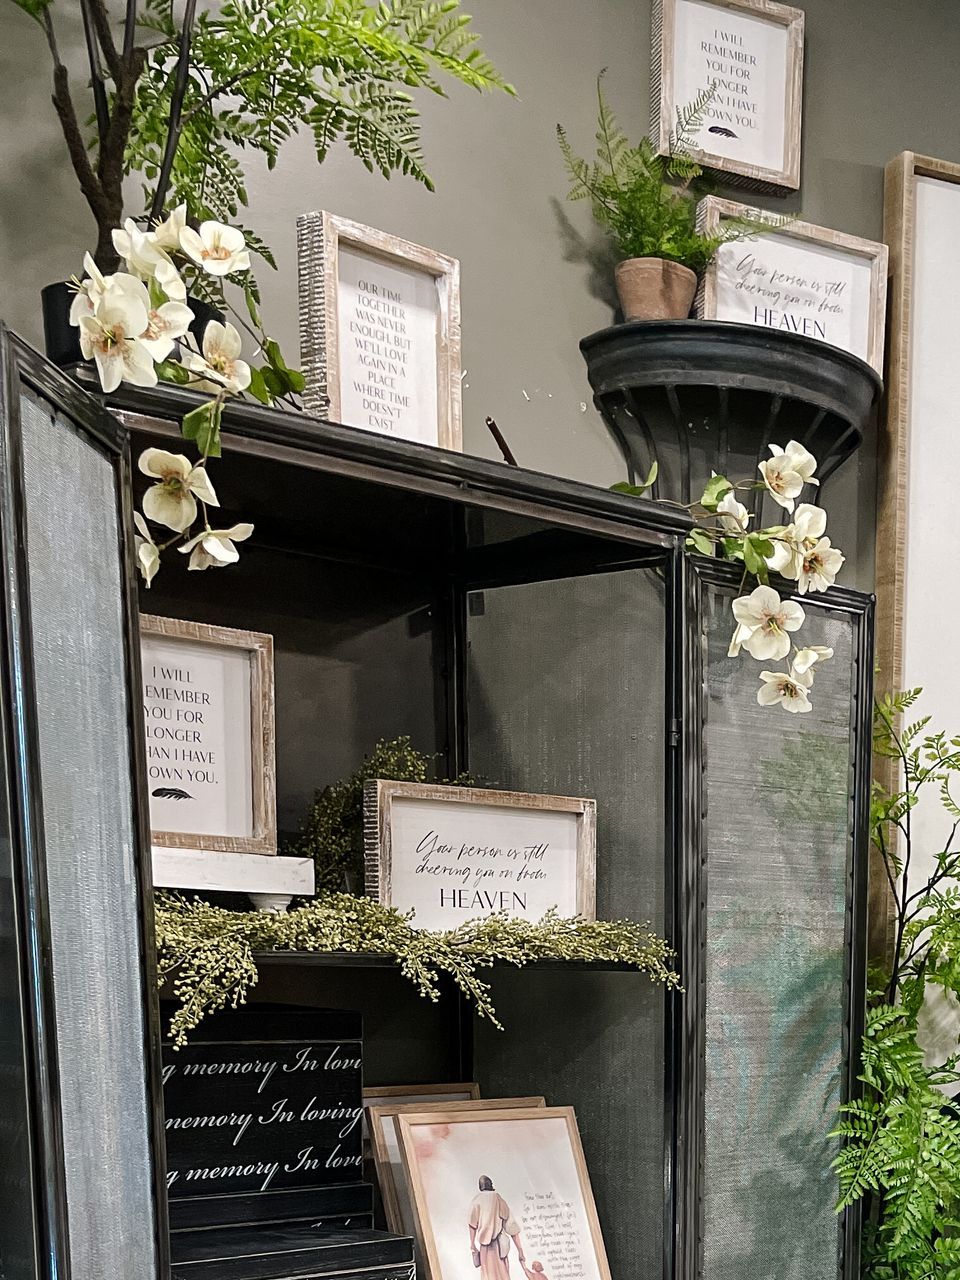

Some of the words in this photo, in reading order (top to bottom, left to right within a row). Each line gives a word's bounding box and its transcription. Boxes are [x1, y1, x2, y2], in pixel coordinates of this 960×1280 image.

[720, 31, 744, 47] WILL
[701, 41, 757, 66] REMEMBER
[706, 59, 728, 73] YOU
[730, 65, 751, 80] FOR
[707, 75, 748, 95] LONGER
[732, 98, 758, 114] HAVE
[770, 270, 807, 284] person
[358, 280, 379, 296] OUR
[381, 287, 402, 303] TIME
[356, 294, 406, 321] TOGETHER
[355, 308, 376, 324] WAS
[378, 317, 406, 334] NEVER
[754, 306, 826, 338] HEAVEN
[394, 336, 411, 351] BUT
[359, 353, 386, 371] AGAIN
[384, 347, 407, 365] LOVE
[368, 371, 395, 389] PLACE
[354, 381, 386, 401] WHERE
[389, 391, 410, 408] TIME
[161, 667, 194, 684] WILL
[146, 685, 211, 706] EMEMBER
[143, 704, 173, 720] YOU
[176, 708, 204, 725] FOR
[146, 725, 202, 744] LONGER
[182, 749, 216, 765] HAVE
[186, 769, 219, 784] YOU.
[416, 830, 452, 860] Your
[458, 843, 505, 861] person
[524, 843, 550, 863] still
[415, 858, 471, 884] cheering
[475, 869, 495, 888] you
[499, 870, 513, 878] on
[516, 864, 547, 882] from
[440, 888, 527, 910] HEAVEN
[184, 1058, 278, 1094] memory
[282, 1046, 319, 1072] In
[258, 1098, 296, 1125] In
[300, 1097, 364, 1138] loving
[186, 1158, 280, 1191] memory
[284, 1146, 320, 1172] In
